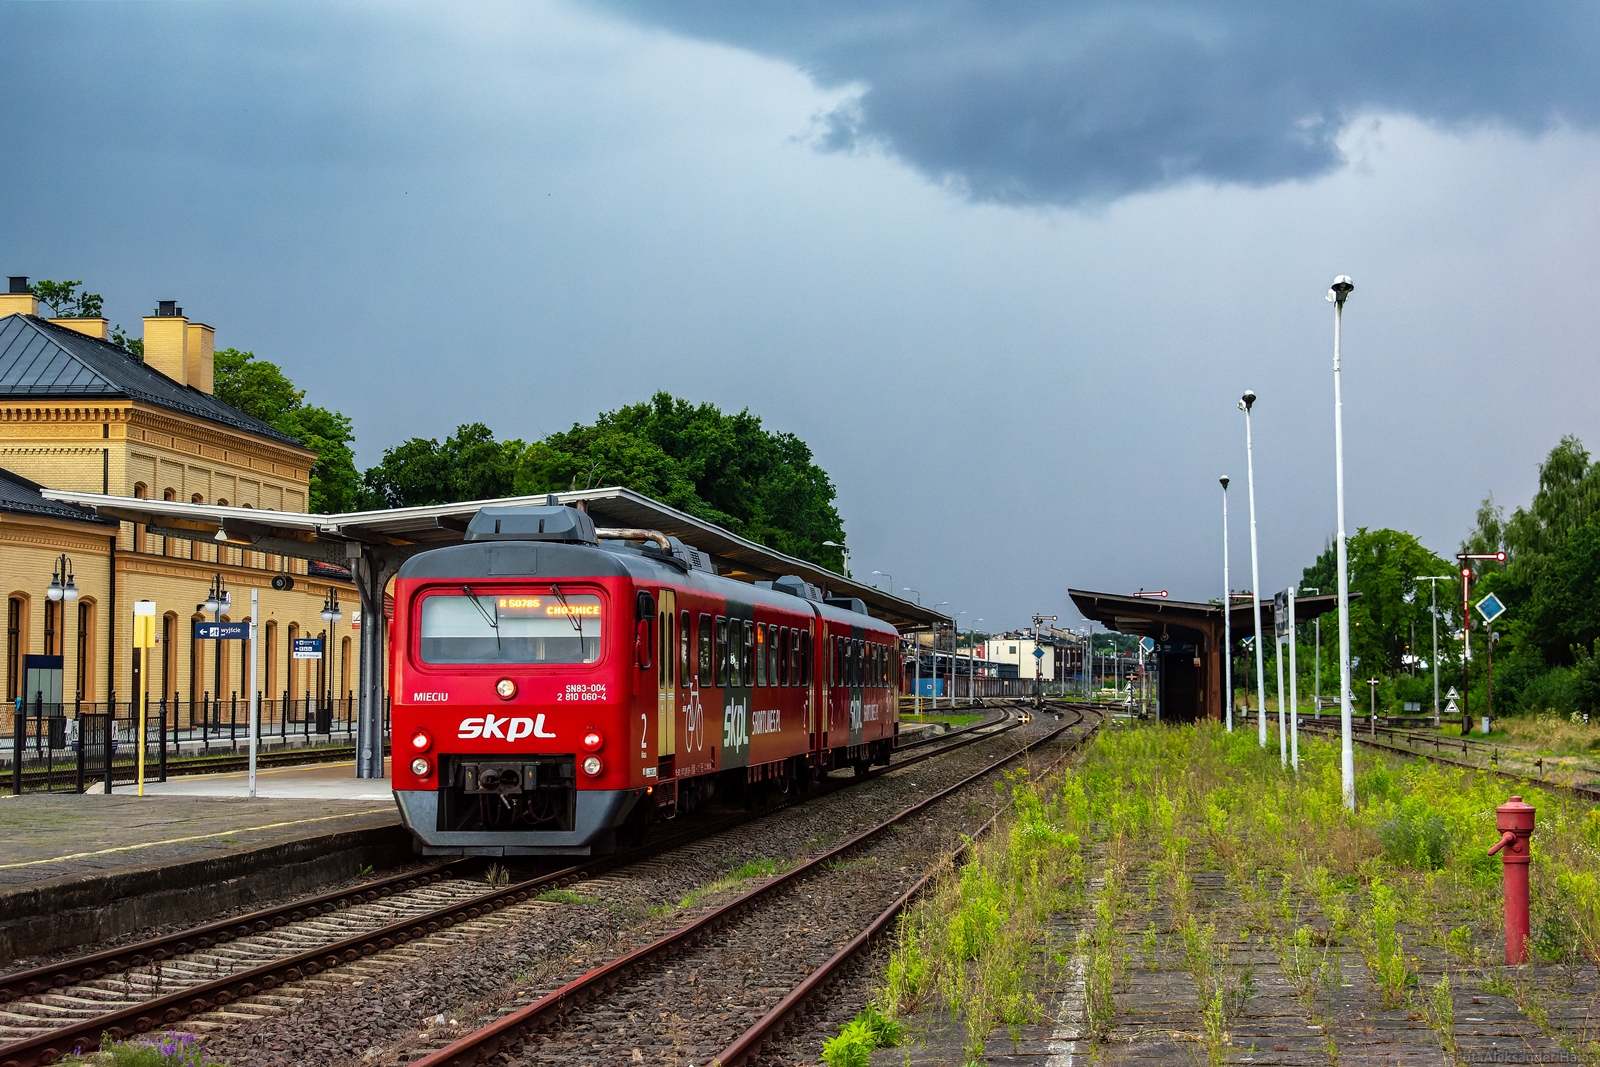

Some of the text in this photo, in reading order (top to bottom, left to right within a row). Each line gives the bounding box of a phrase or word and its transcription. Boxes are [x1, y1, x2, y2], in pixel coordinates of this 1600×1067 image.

[508, 599, 540, 608] 50785
[565, 684, 606, 693] SN83-004
[413, 692, 448, 702] MIECIU
[557, 692, 606, 701] 2 810 060-4
[641, 713, 647, 749] 2
